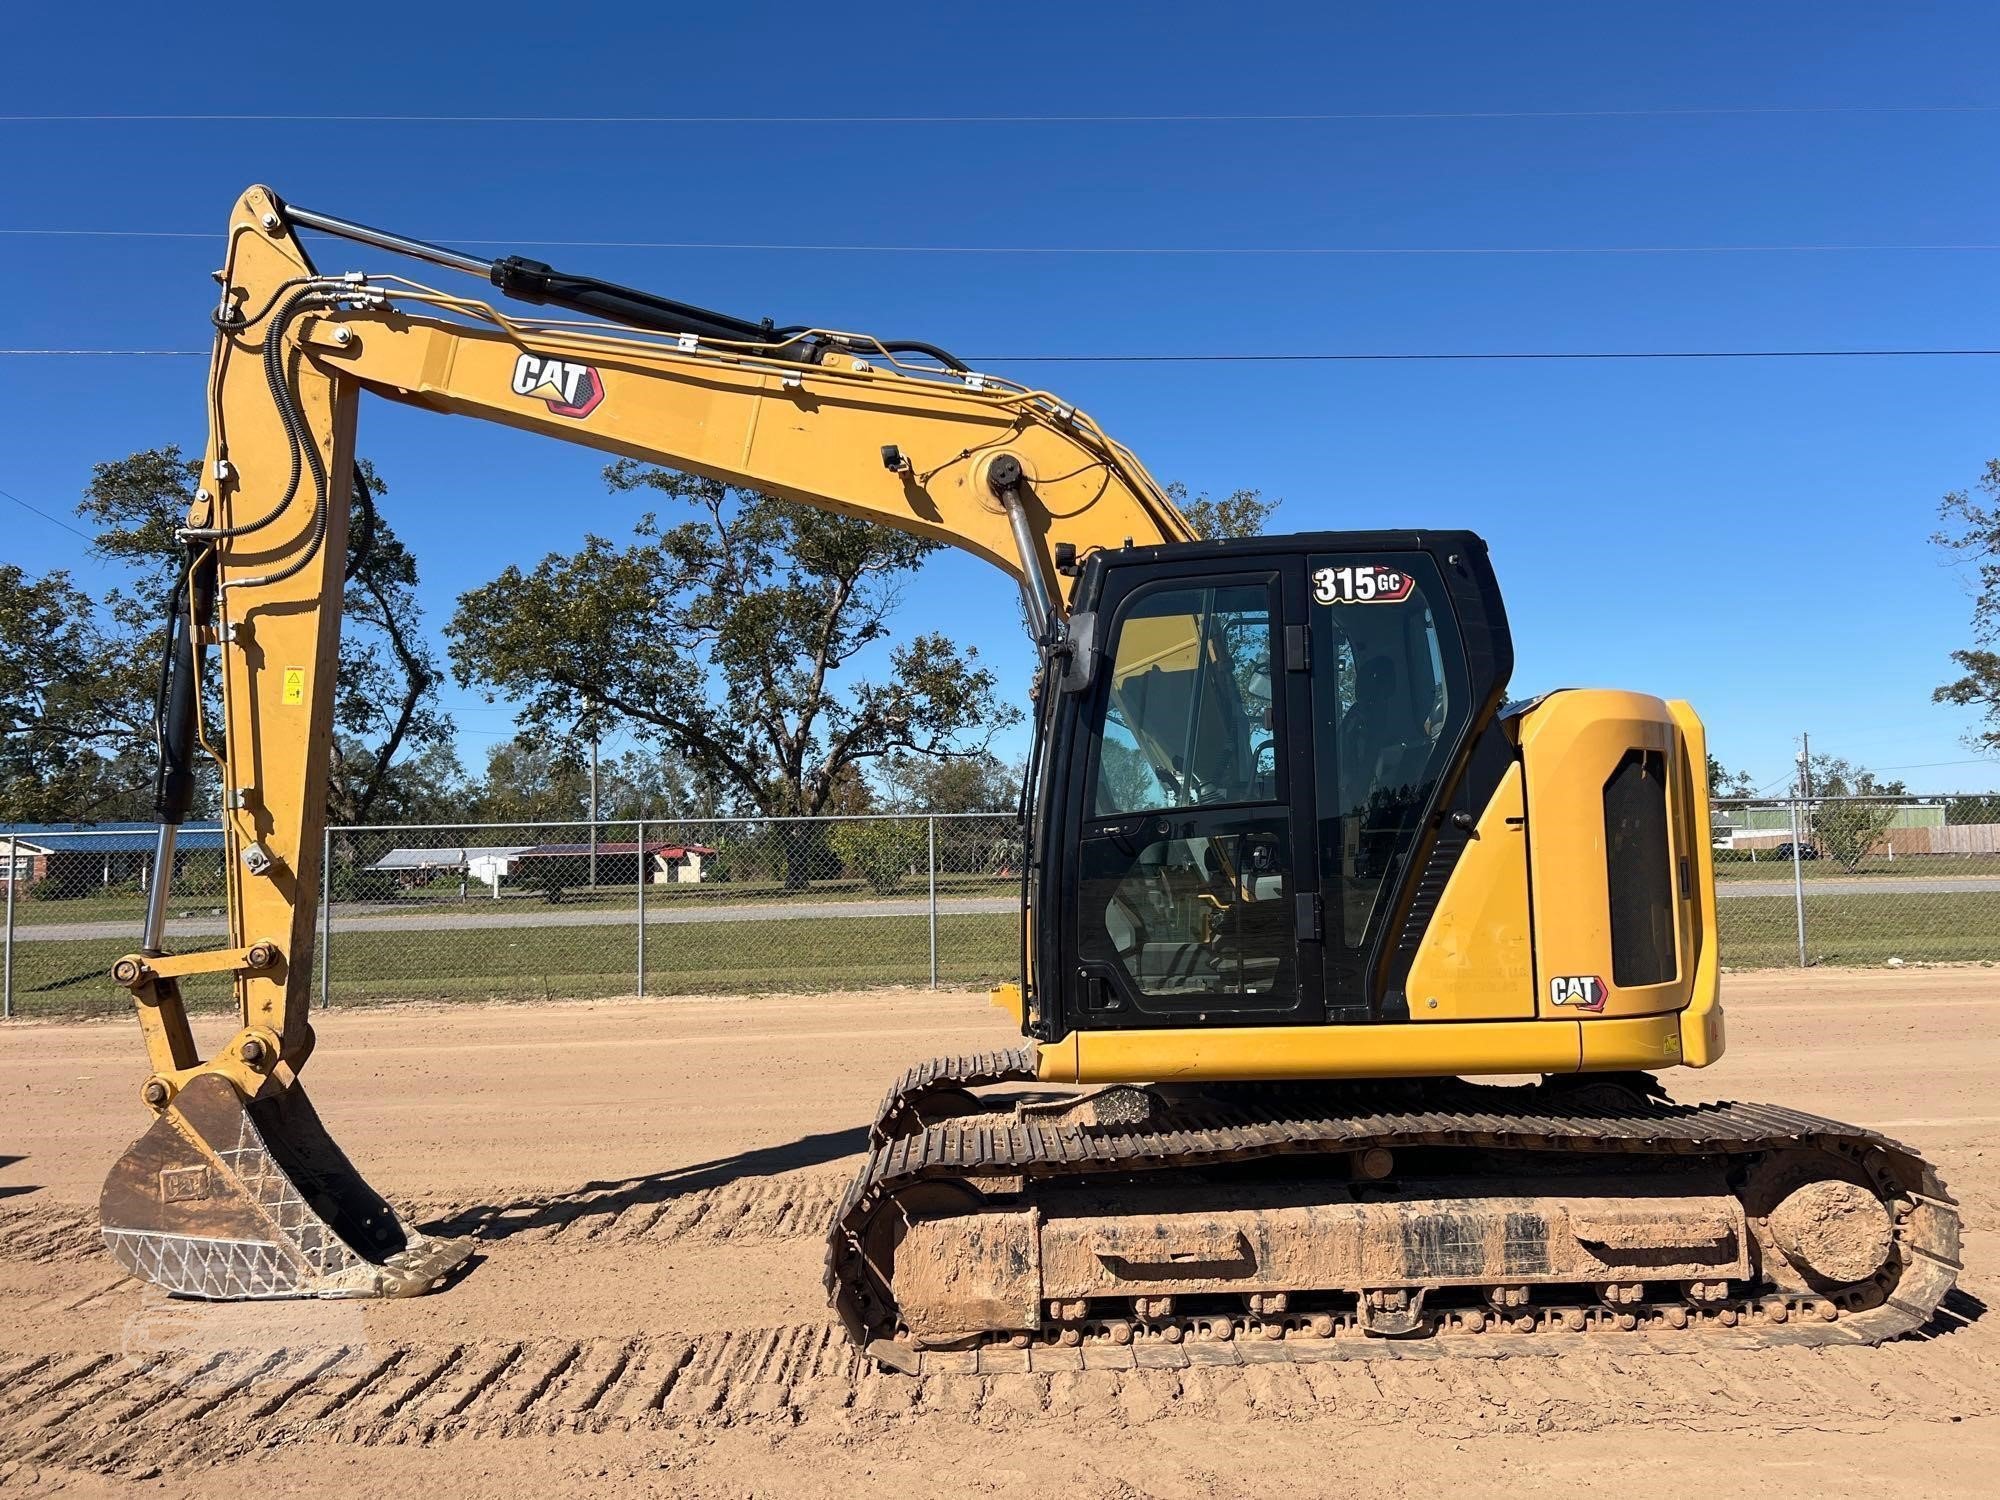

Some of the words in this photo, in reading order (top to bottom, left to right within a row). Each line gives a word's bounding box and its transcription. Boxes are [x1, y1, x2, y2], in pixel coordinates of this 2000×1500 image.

[513, 353, 587, 405] CAT
[1315, 566, 1376, 601] 315
[1377, 573, 1400, 591] GC
[1551, 977, 1595, 1005] CAT
